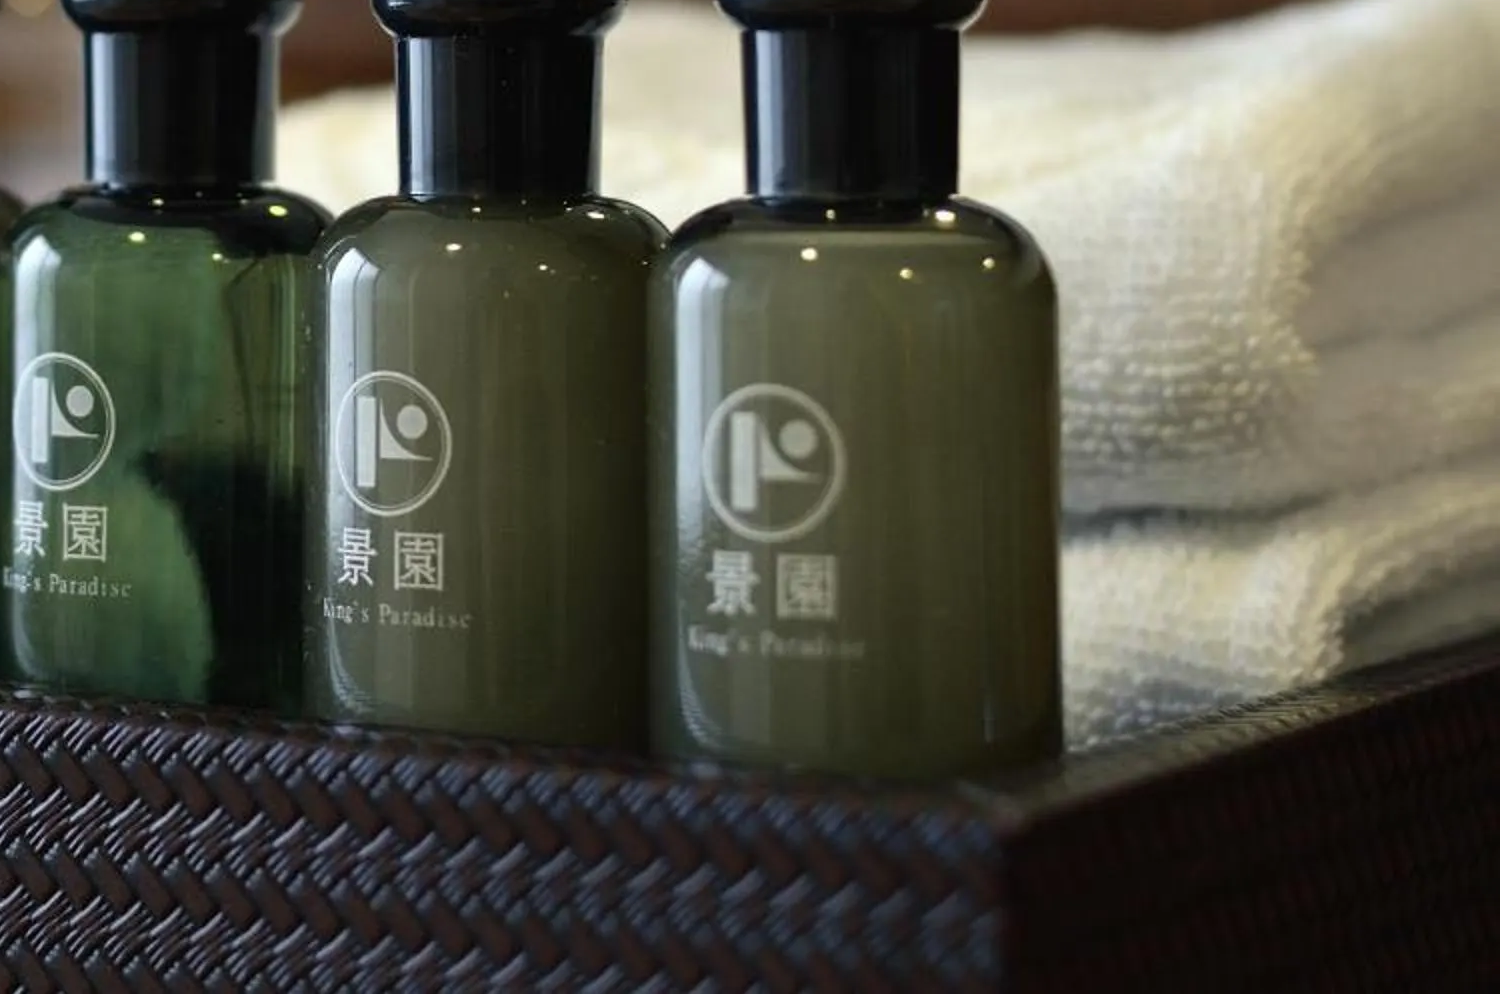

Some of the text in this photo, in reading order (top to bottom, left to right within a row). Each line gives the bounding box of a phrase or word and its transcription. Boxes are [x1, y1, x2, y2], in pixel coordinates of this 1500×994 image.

[14, 500, 108, 562] 景園
[337, 526, 444, 591] 景園
[49, 573, 132, 598] Paradise
[322, 597, 473, 629] King's Paradise
[705, 550, 838, 620] 景園
